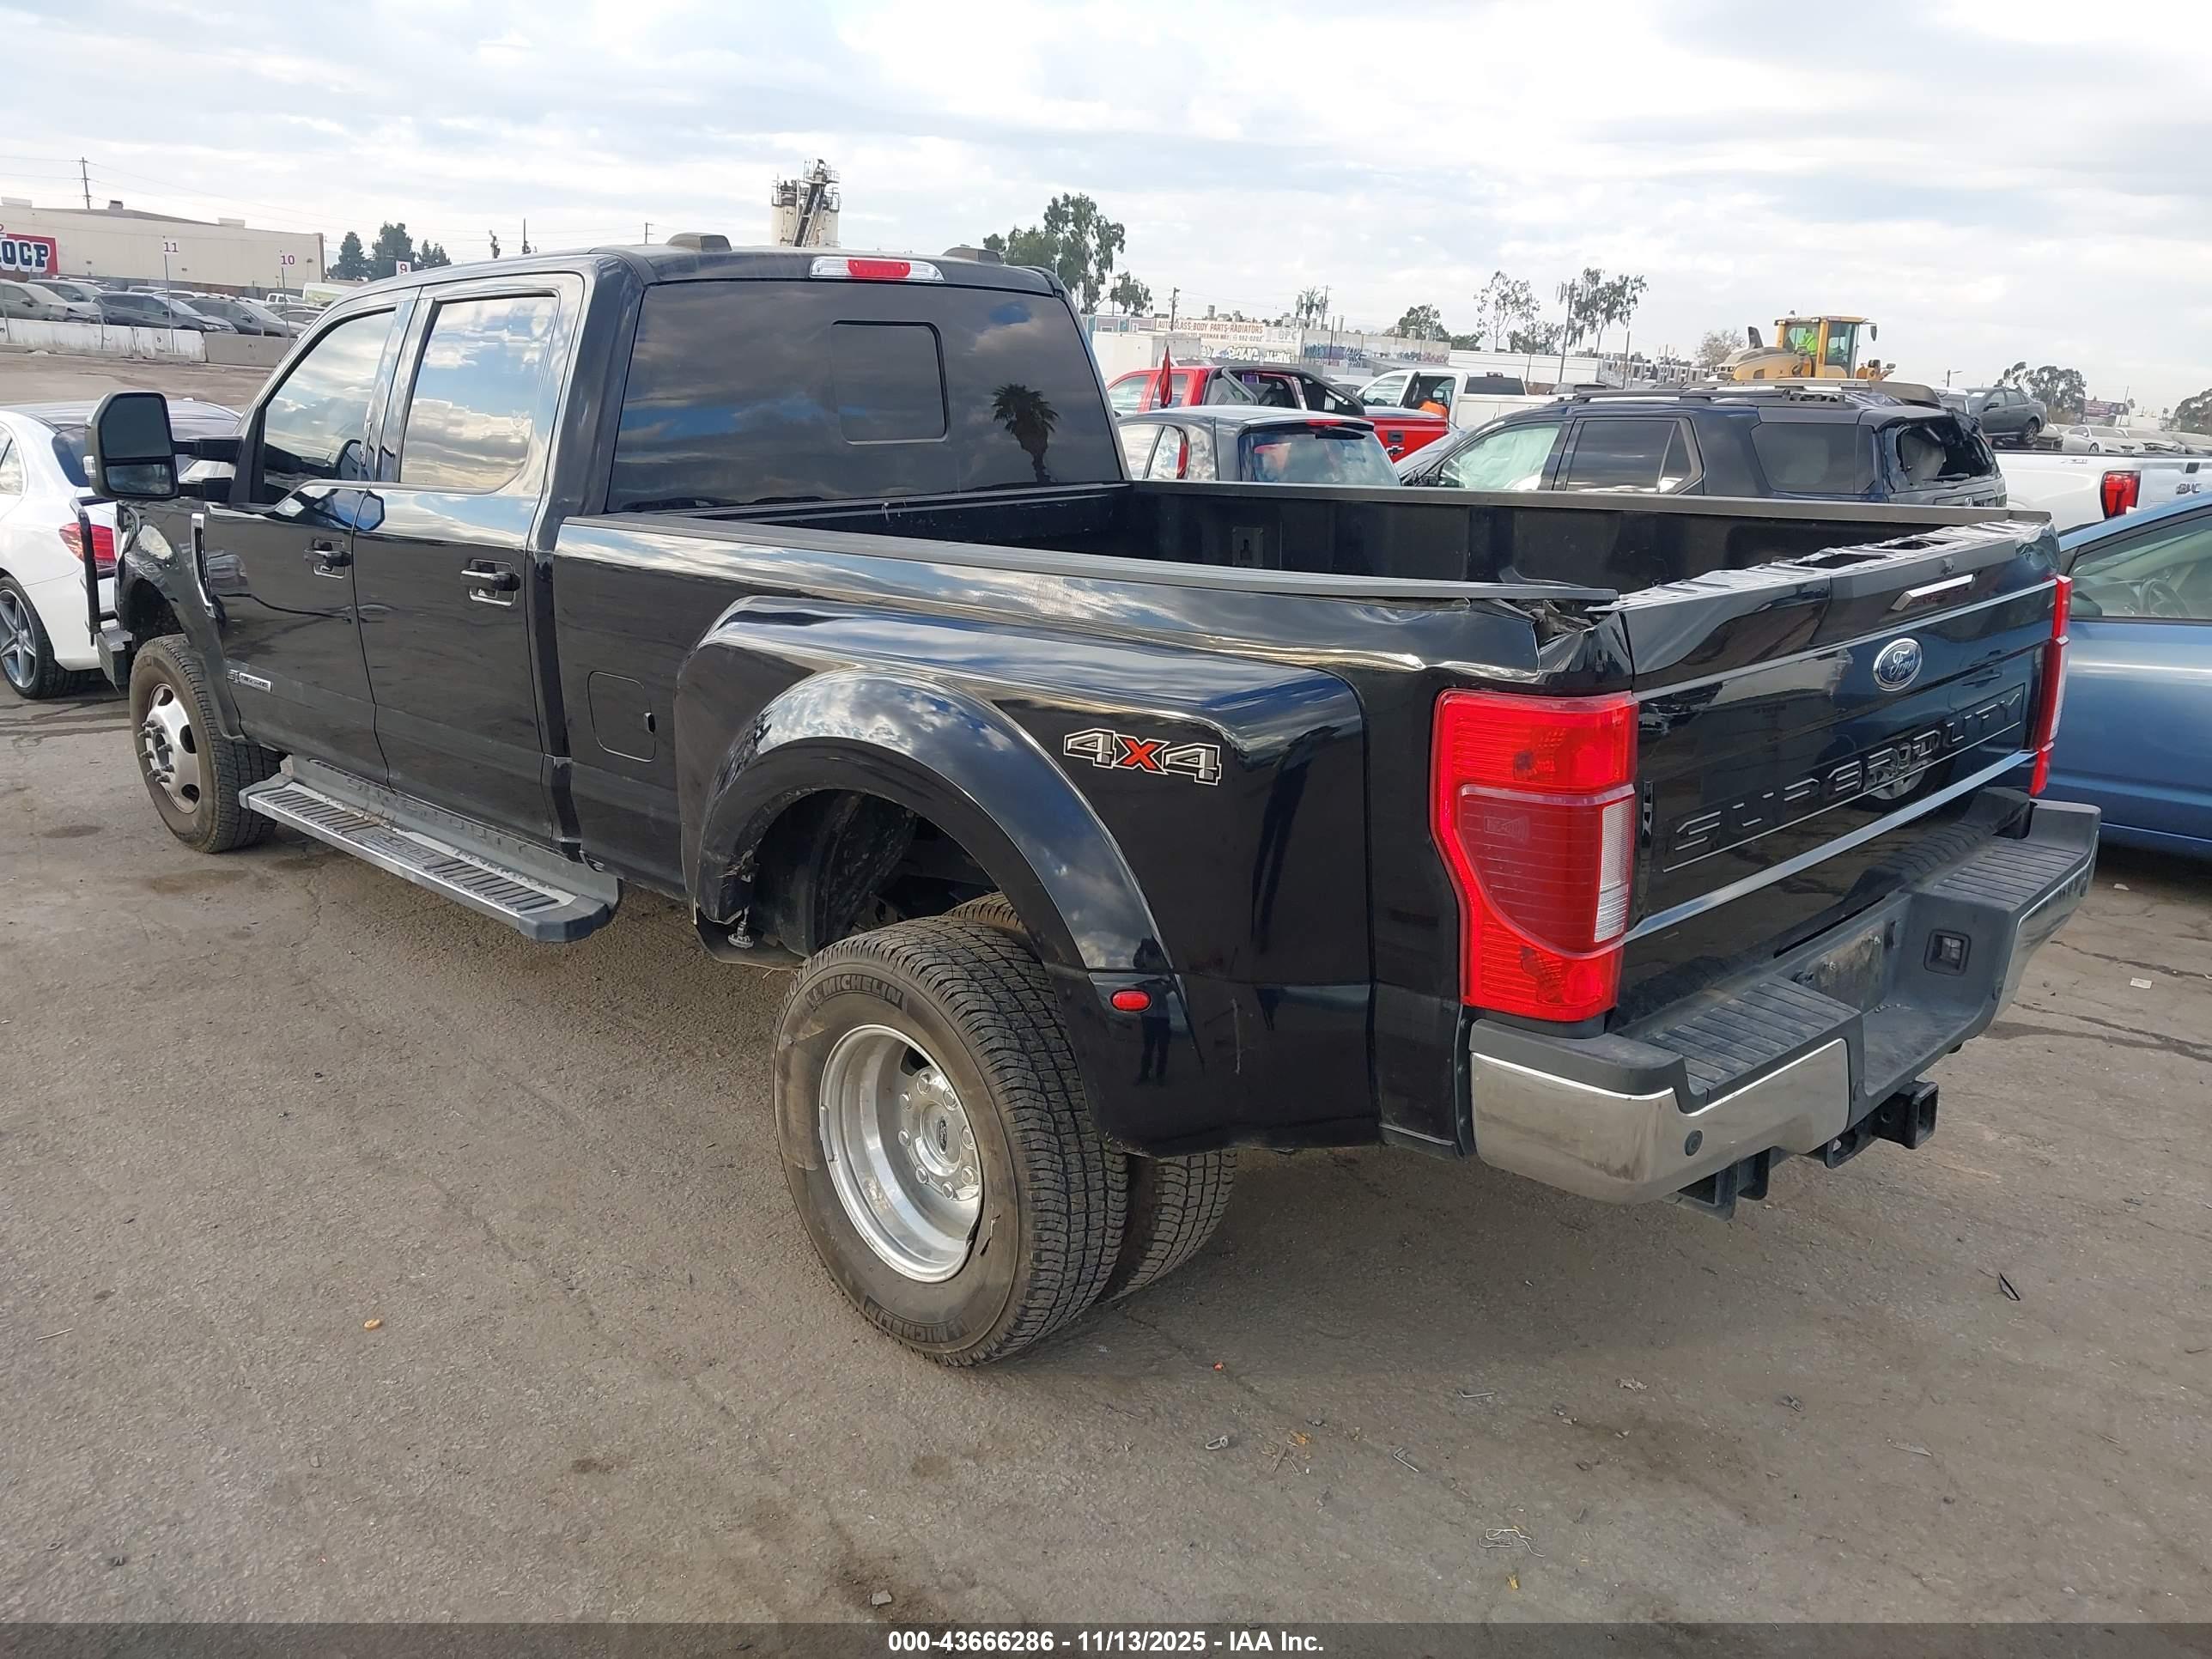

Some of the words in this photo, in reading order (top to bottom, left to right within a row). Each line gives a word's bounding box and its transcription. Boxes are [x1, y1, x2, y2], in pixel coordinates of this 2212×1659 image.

[0, 240, 49, 268] OCP
[164, 241, 179, 252] 11
[280, 255, 295, 265] 10
[399, 263, 408, 273] 9
[1890, 648, 1916, 679] Ford
[1674, 746, 1898, 852] SUPER
[1911, 693, 2021, 759] DUTY
[822, 974, 903, 1005] MICHELIN
